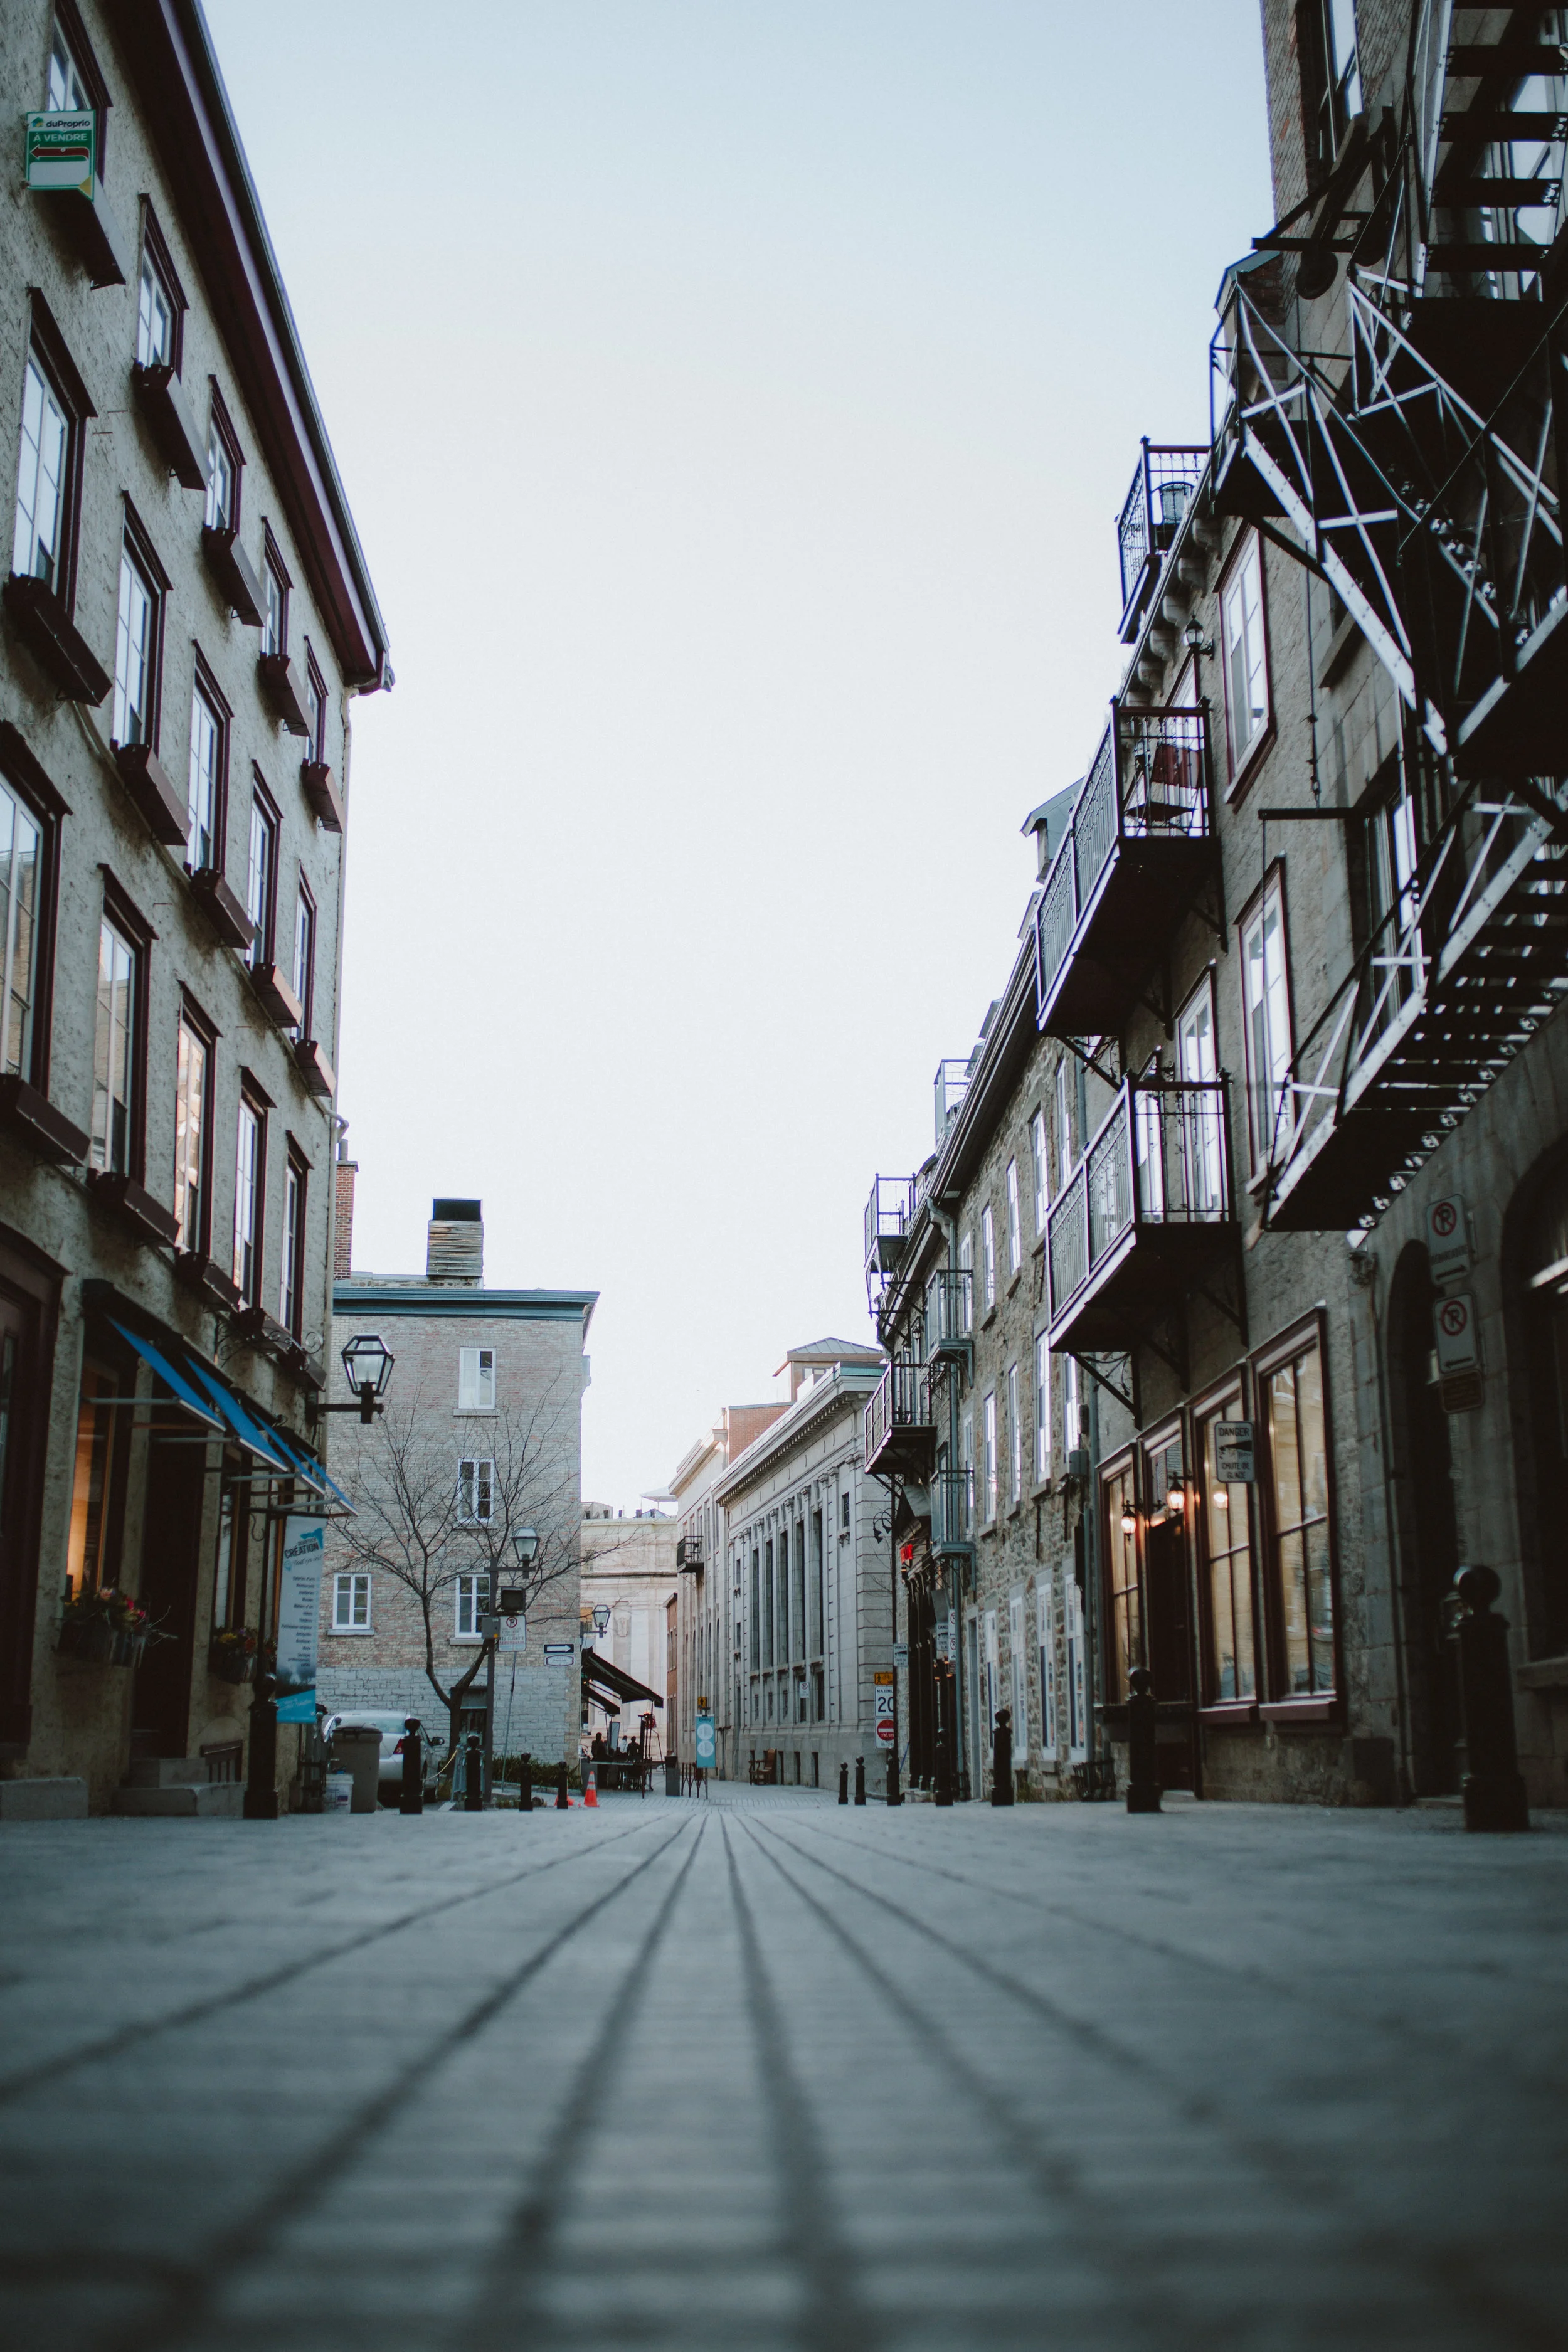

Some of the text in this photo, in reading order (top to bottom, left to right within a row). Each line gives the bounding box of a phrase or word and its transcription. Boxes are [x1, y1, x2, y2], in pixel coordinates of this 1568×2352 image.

[46, 119, 90, 128] duProprio
[44, 133, 88, 142] VENDRE
[1219, 1427, 1249, 1437] DANGER
[1222, 1462, 1240, 1470] CHUTE
[1227, 1471, 1246, 1480] GLACE
[284, 1542, 319, 1559] CRÉATION
[878, 1697, 894, 1712] 20
